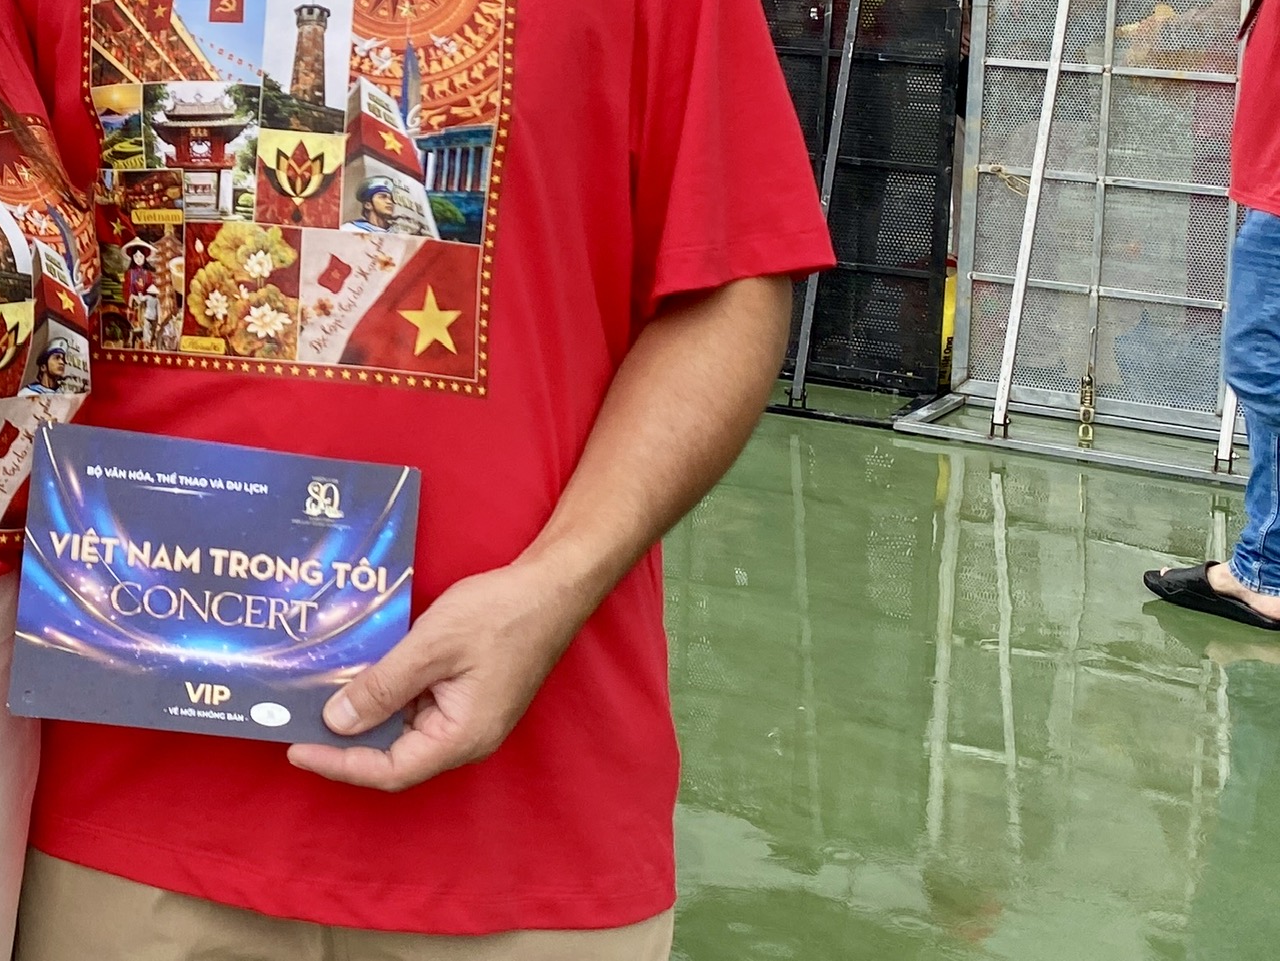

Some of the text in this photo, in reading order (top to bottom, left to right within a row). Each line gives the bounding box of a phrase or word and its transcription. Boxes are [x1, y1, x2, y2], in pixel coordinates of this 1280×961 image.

[134, 211, 181, 222] Vietnam
[86, 465, 103, 479] BỘ
[104, 466, 127, 480] VĂN
[128, 469, 154, 483] HÓA,
[178, 474, 209, 488] THAO
[209, 476, 224, 490] VÀ
[226, 480, 242, 492] DU
[244, 481, 269, 496] LỊCH
[49, 527, 387, 594] VIỆT NAM TRONG TÔI
[110, 581, 319, 641] CONCERT
[184, 681, 232, 706] VIP
[197, 709, 226, 720] KHÔNG
